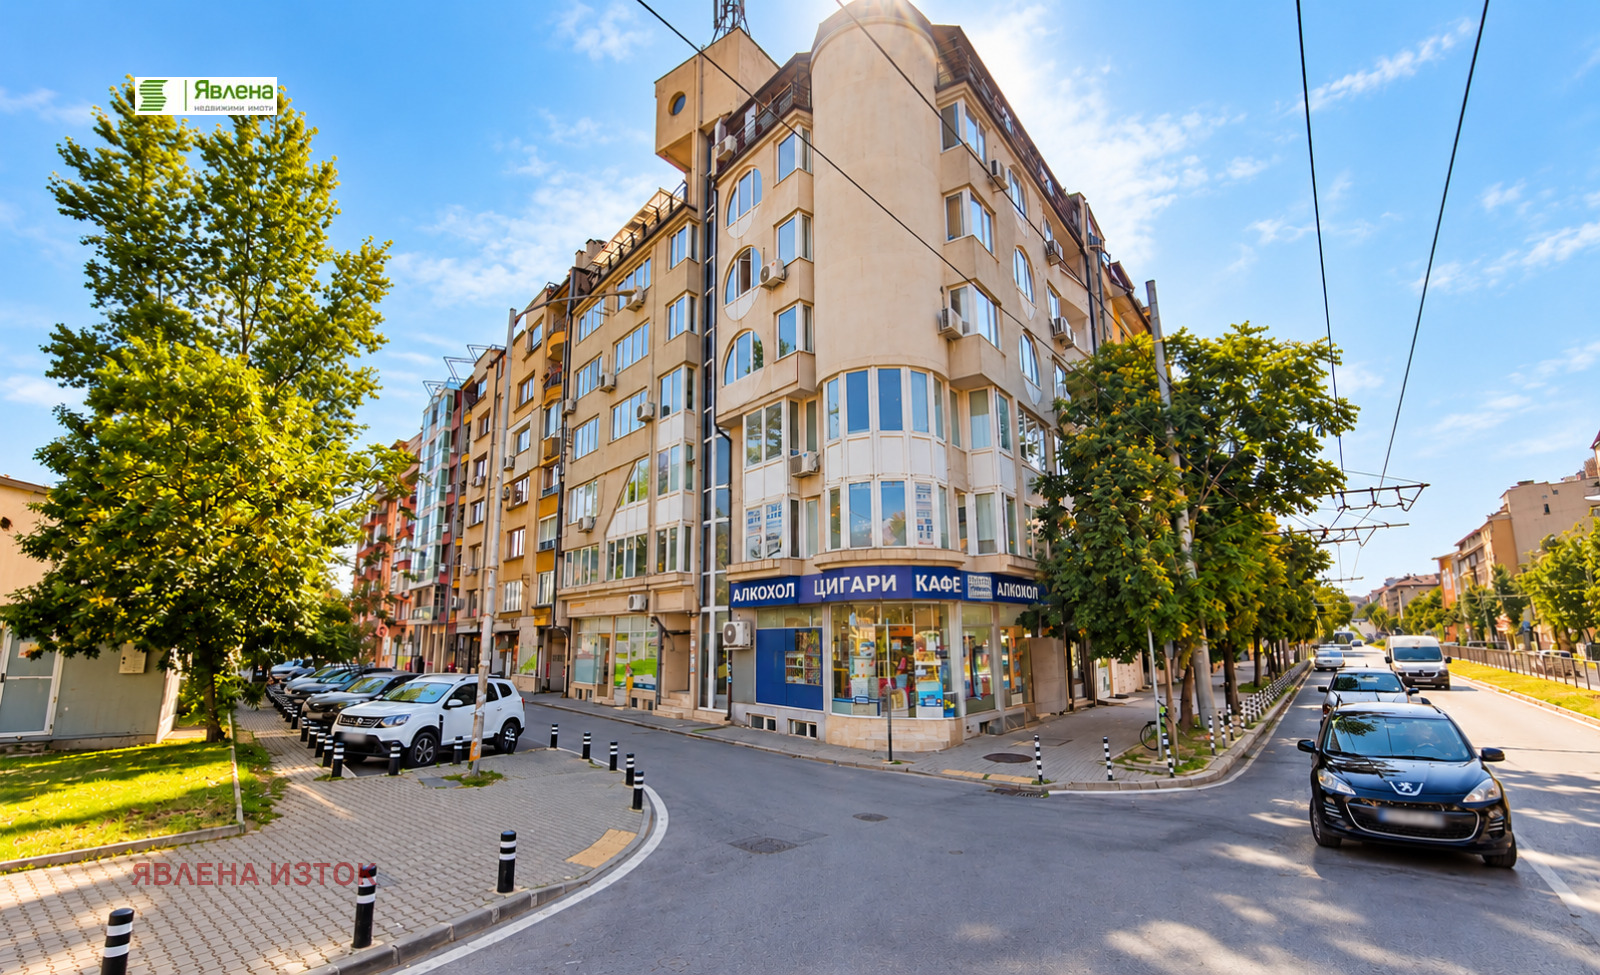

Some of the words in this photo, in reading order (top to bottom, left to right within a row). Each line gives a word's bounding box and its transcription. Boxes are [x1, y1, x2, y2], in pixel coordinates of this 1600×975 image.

[733, 582, 795, 602] АЛКОХОЛ
[814, 574, 897, 599] ЦИГАРИ
[915, 574, 962, 593] КАФЕ
[997, 581, 1039, 600] АЛКОХОЛ
